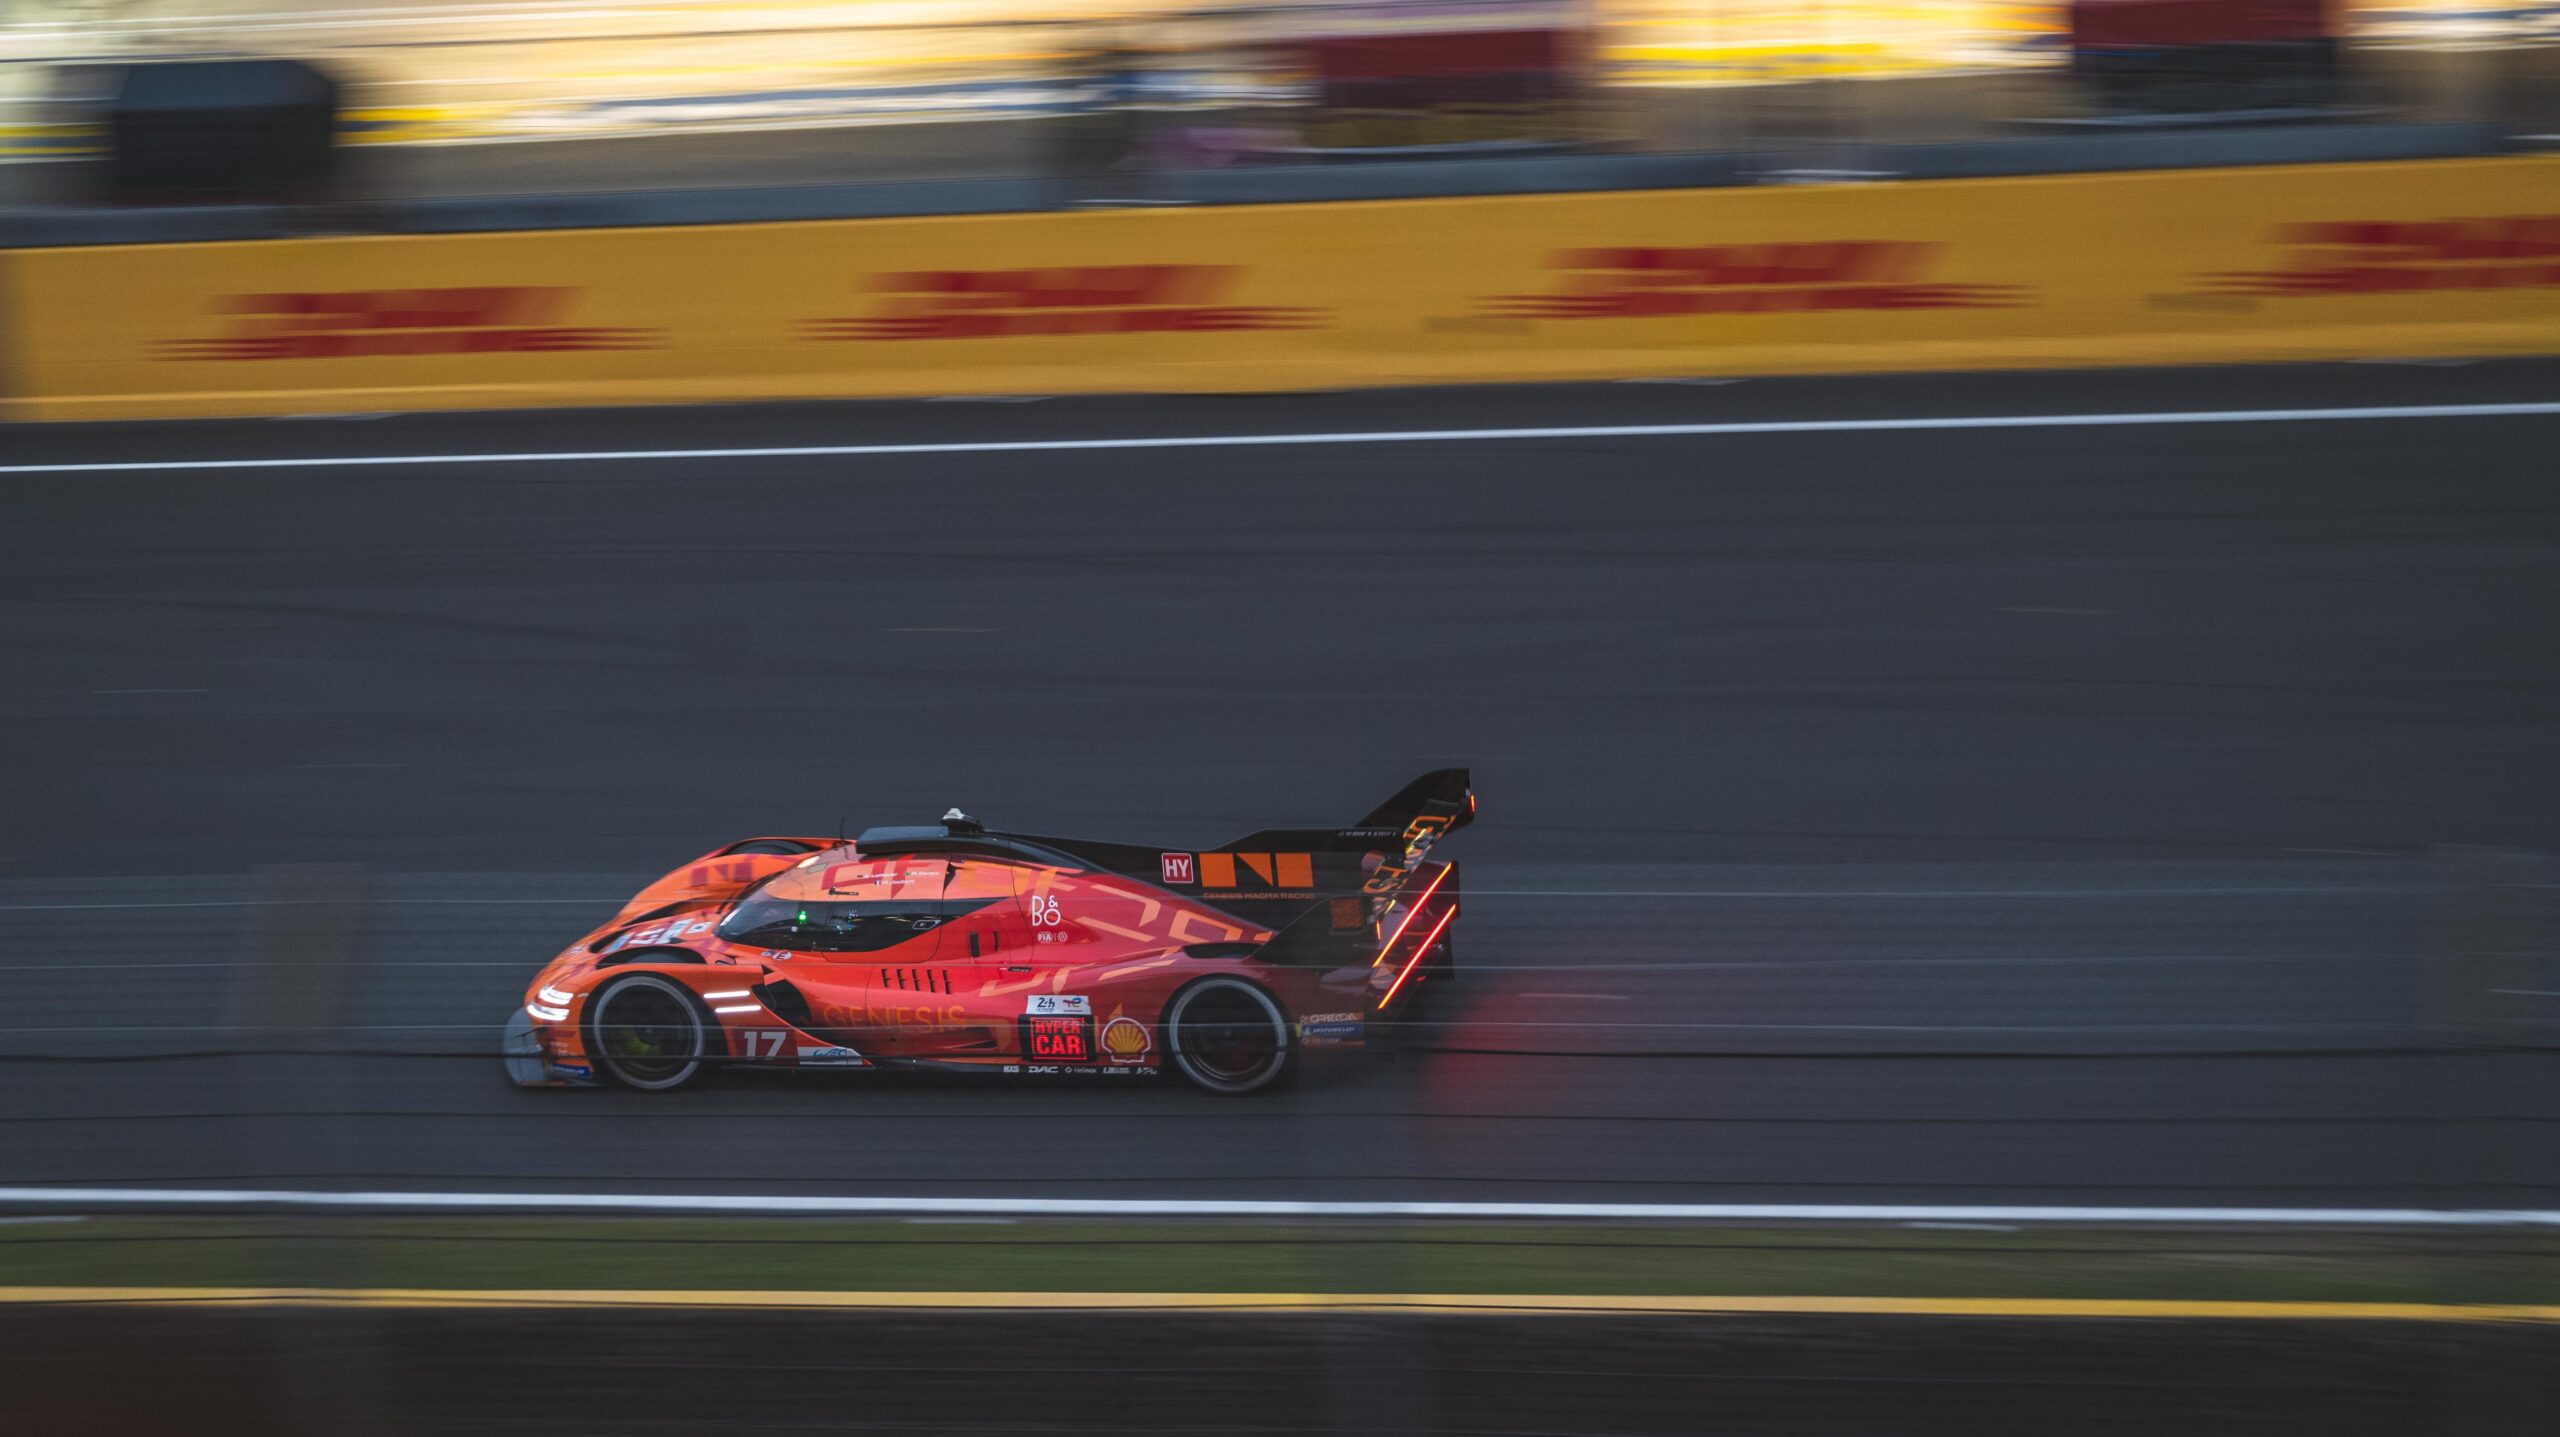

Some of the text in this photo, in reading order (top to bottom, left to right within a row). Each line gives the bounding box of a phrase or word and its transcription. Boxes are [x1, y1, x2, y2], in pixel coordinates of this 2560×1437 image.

[1164, 859, 1189, 878] HY
[1038, 933, 1052, 941] FIA
[823, 1004, 968, 1034] GENESIS
[1035, 1020, 1081, 1034] HYPER
[744, 1031, 787, 1060] 17
[1036, 1034, 1082, 1055] CAR
[1028, 1066, 1059, 1074] DAC
